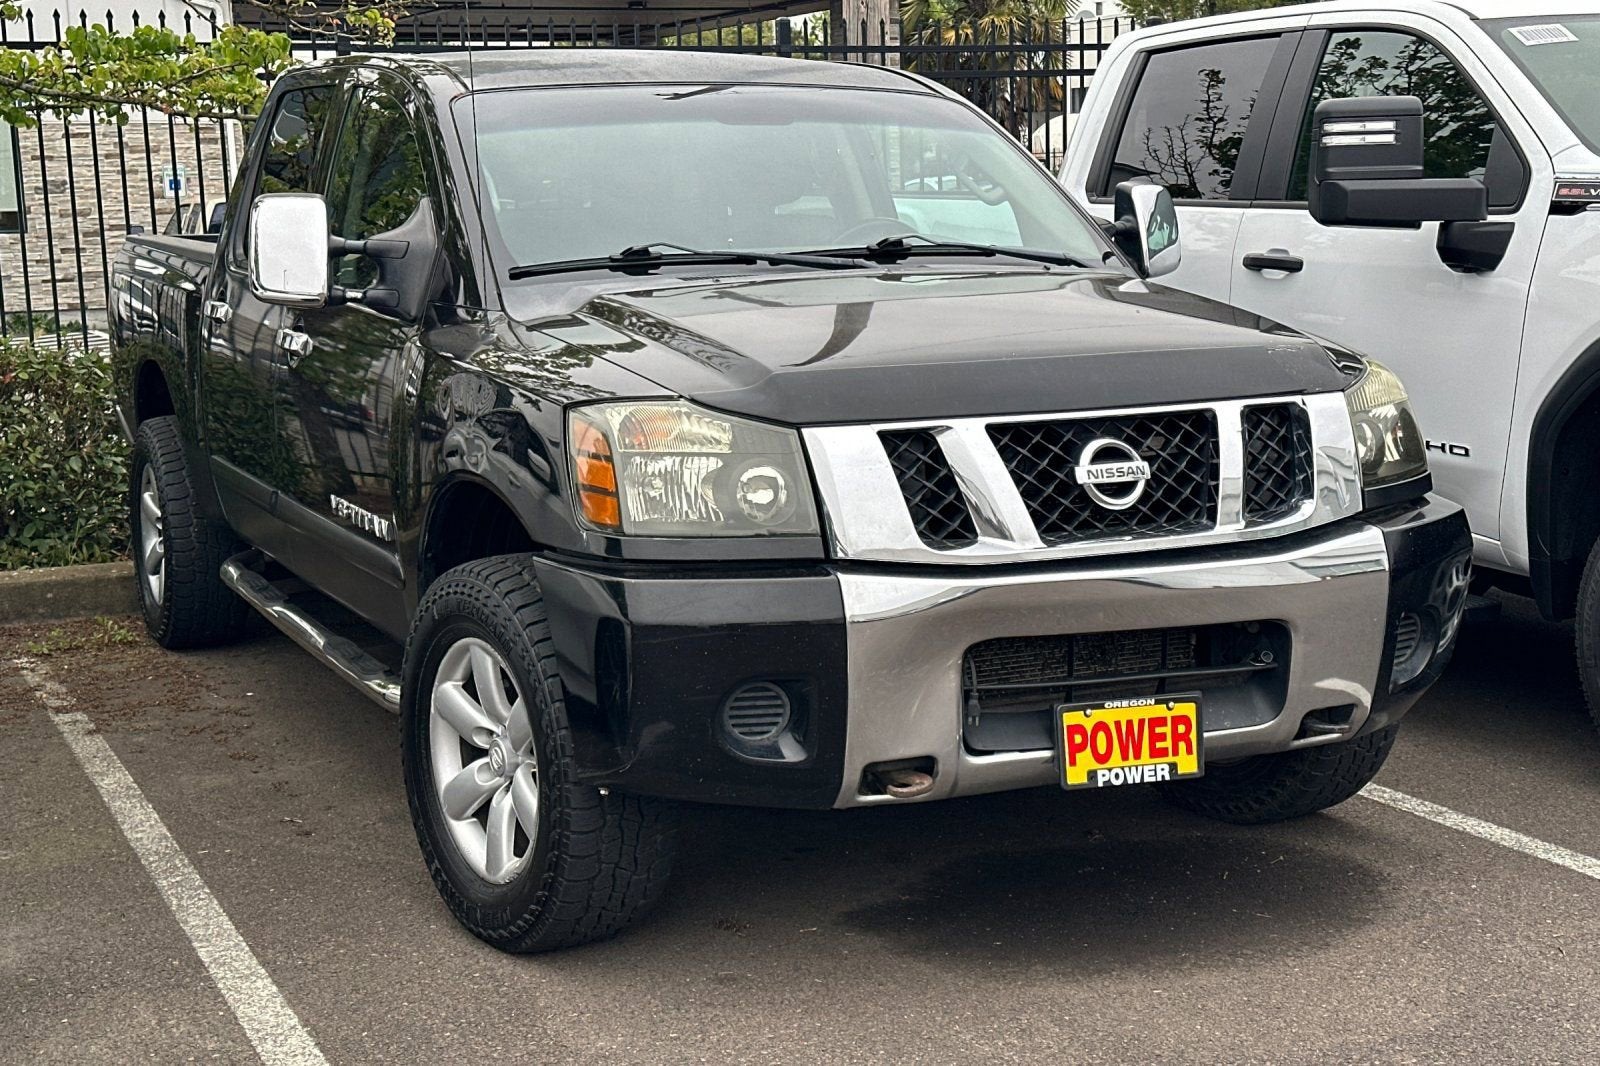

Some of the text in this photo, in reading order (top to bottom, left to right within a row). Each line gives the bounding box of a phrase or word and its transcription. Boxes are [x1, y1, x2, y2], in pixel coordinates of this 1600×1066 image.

[1425, 440, 1471, 458] HD
[1086, 465, 1146, 481] NISSAN
[1104, 699, 1156, 709] OREGON
[1066, 714, 1194, 767] POWER
[1096, 763, 1171, 788] POWER
